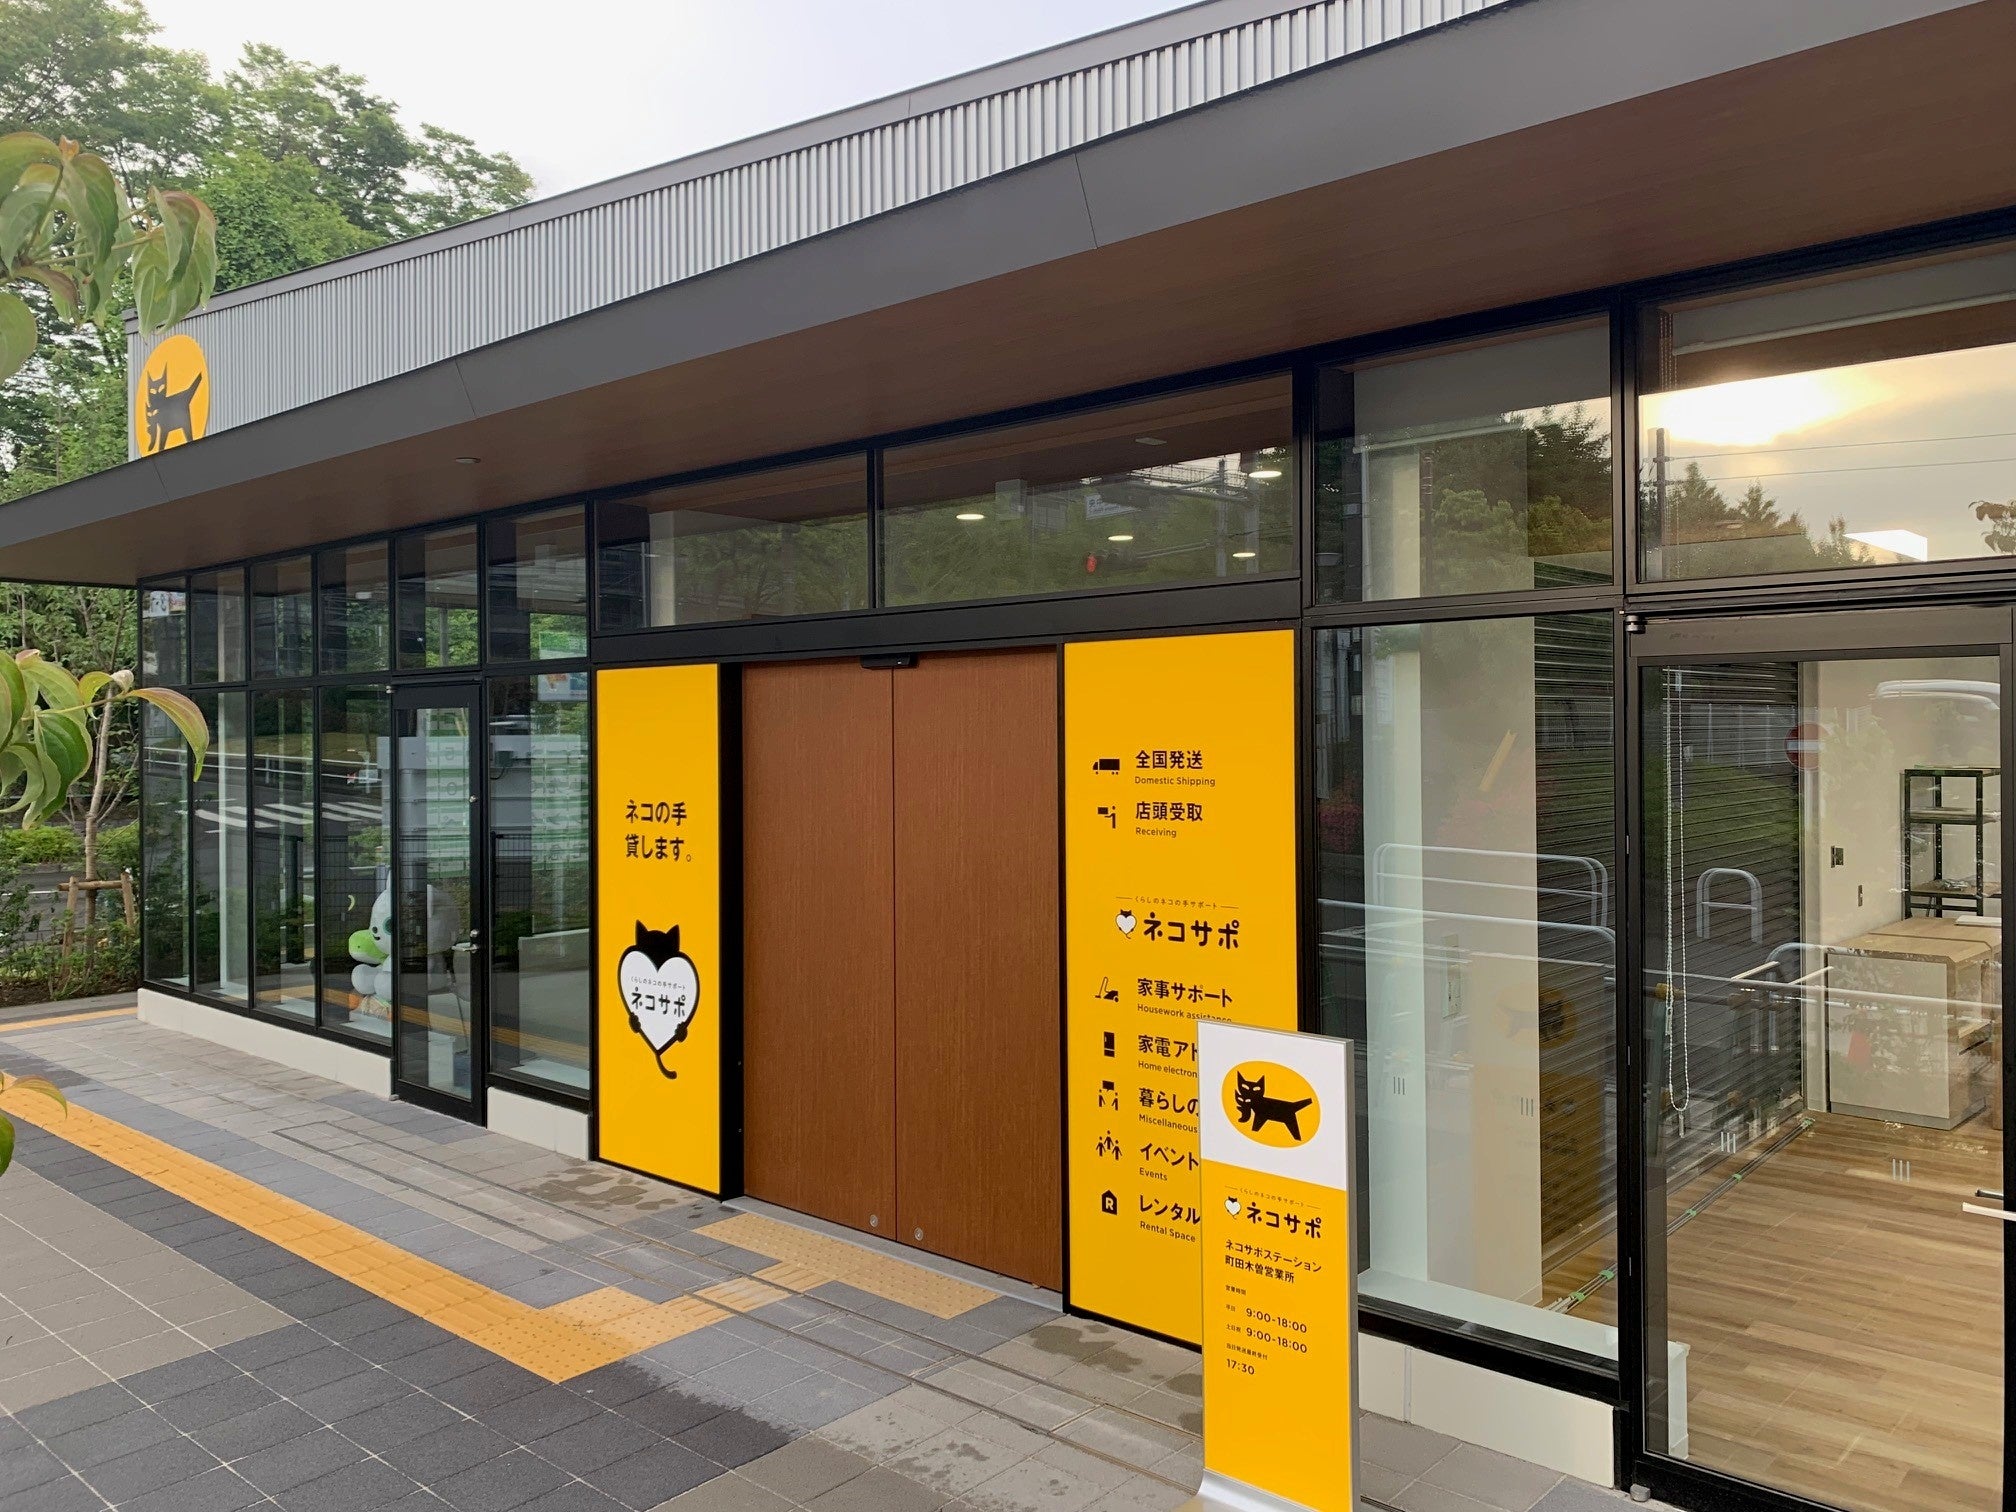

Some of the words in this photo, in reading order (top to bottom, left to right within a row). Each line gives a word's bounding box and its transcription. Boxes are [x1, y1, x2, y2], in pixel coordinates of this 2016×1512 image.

[1135, 750, 1204, 770] 全国発送
[1134, 776, 1174, 785] Domestic
[1176, 776, 1216, 787] Shipping
[625, 799, 687, 827] ネコの手
[1135, 802, 1204, 822] 店頭受取
[1135, 827, 1177, 838] Receiving
[625, 833, 692, 862] 貸します。
[1135, 896, 1218, 910] くらしのネコの手サポート
[1143, 911, 1240, 950] ネコサポ
[631, 986, 686, 1018] ネコサポ
[1137, 977, 1233, 1008] 家事サポート
[1137, 1003, 1184, 1018] Housework
[1138, 1061, 1162, 1072] Home
[1163, 1065, 1198, 1078] electron
[1138, 1113, 1198, 1134] Miscellaneous
[1140, 1142, 1199, 1171] イベント
[1139, 1167, 1168, 1181] Events
[1105, 1197, 1115, 1211] R
[1139, 1194, 1201, 1225] レンタル
[1140, 1220, 1168, 1236] Rental
[1169, 1228, 1196, 1243] Space
[1246, 1202, 1322, 1239] ネコサポ
[1225, 1239, 1322, 1273] ネコサポステーション
[1225, 1254, 1295, 1283] 町田木曽営業所
[1246, 1307, 1307, 1334] 9:00-18:00
[1246, 1327, 1307, 1353] 9:00-18:00
[1226, 1358, 1255, 1375] 17:30
